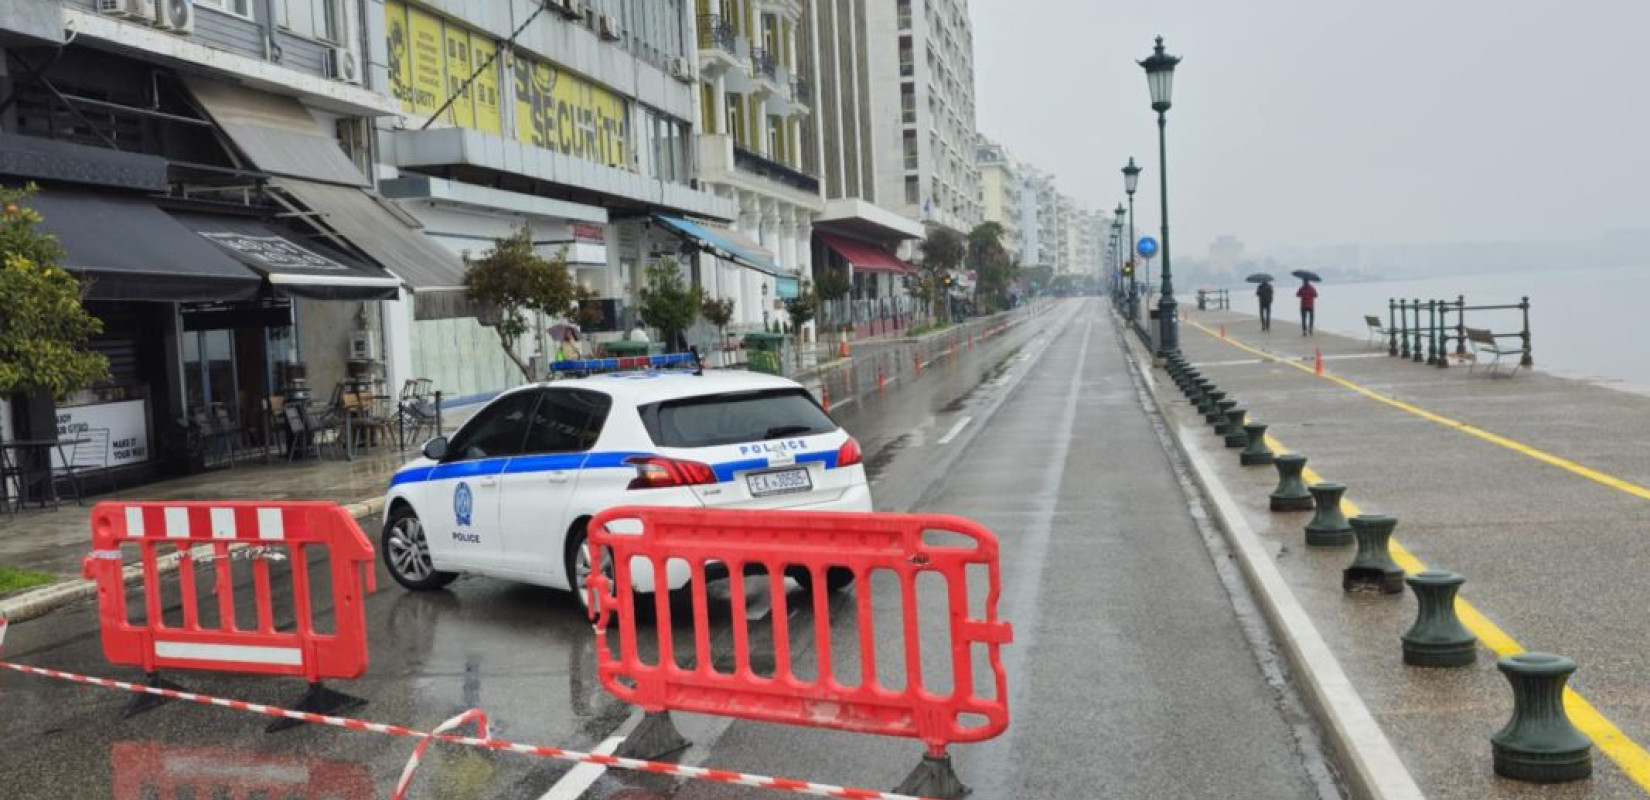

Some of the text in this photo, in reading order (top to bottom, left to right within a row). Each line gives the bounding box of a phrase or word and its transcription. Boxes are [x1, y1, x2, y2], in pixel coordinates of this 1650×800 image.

[740, 439, 806, 454] POLICE
[113, 449, 130, 459] YOUR
[452, 531, 481, 543] POLICE
